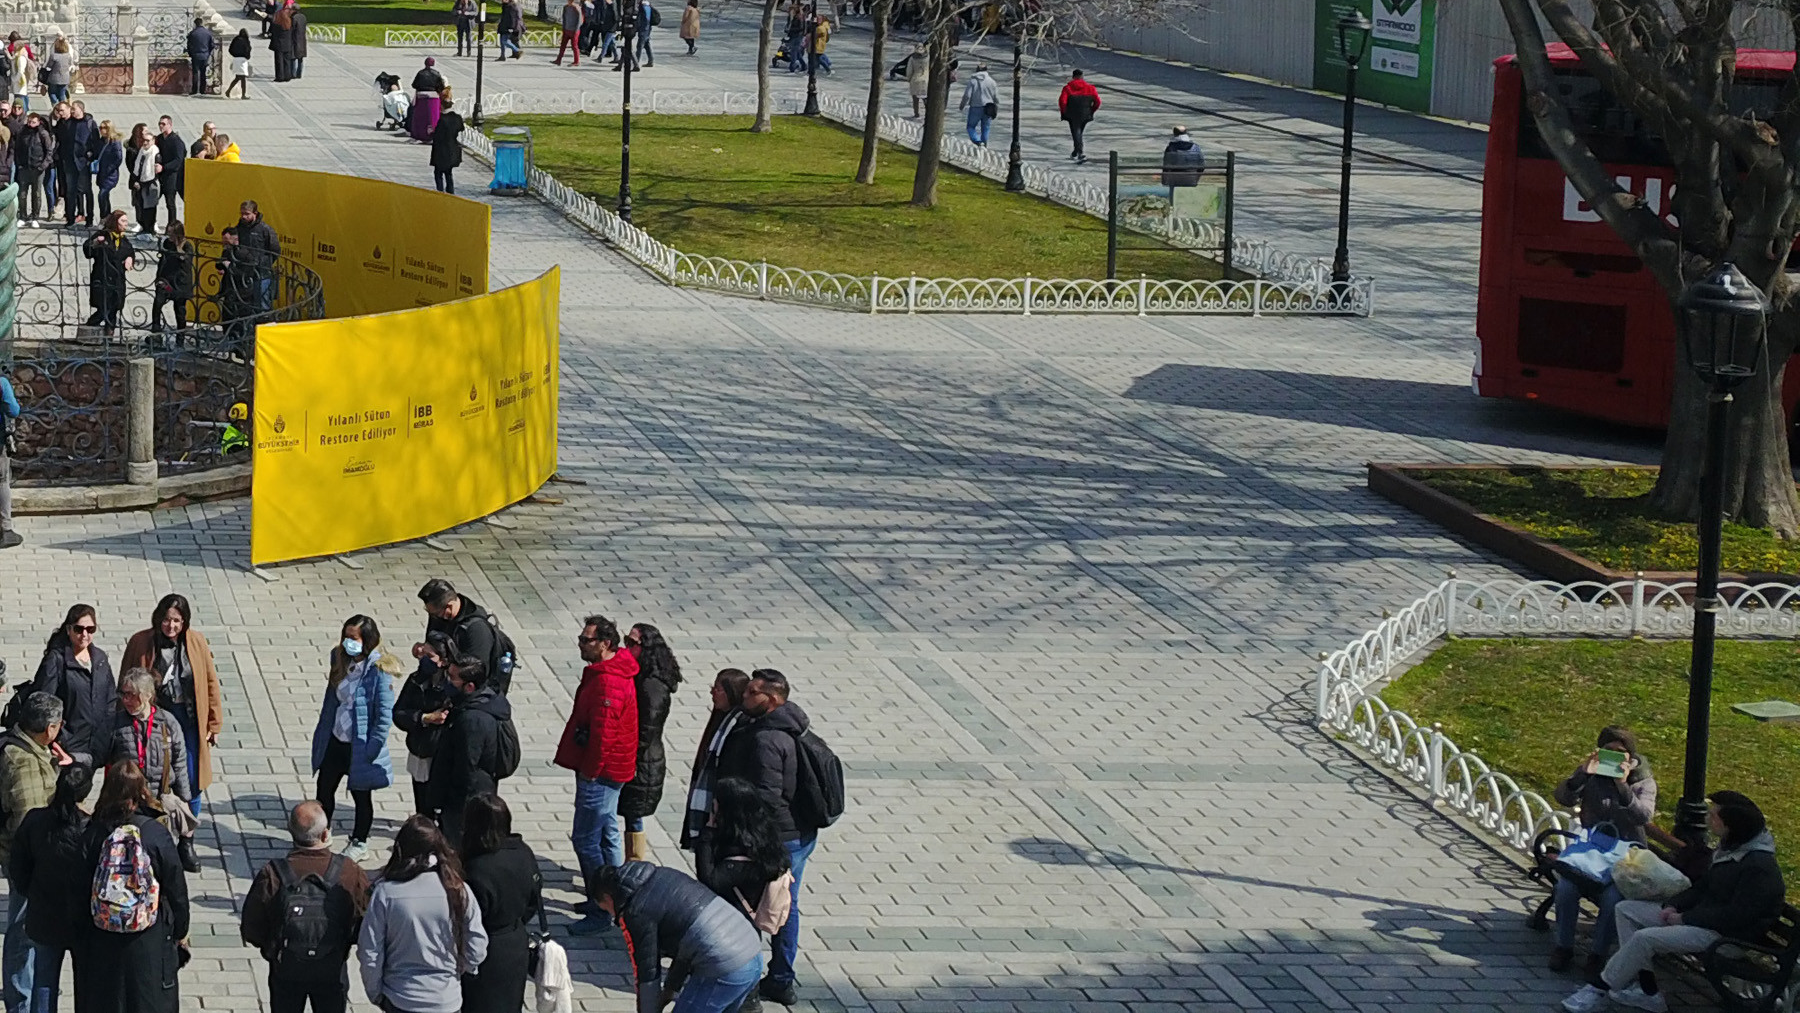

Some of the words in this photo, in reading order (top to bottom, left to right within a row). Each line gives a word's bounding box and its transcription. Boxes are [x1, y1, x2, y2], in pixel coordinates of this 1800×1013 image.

[328, 412, 361, 427] Yılanlı
[364, 409, 390, 423] Sütun
[414, 405, 432, 419] İBB
[320, 433, 359, 446] Restore
[362, 427, 397, 441] Ediliyor
